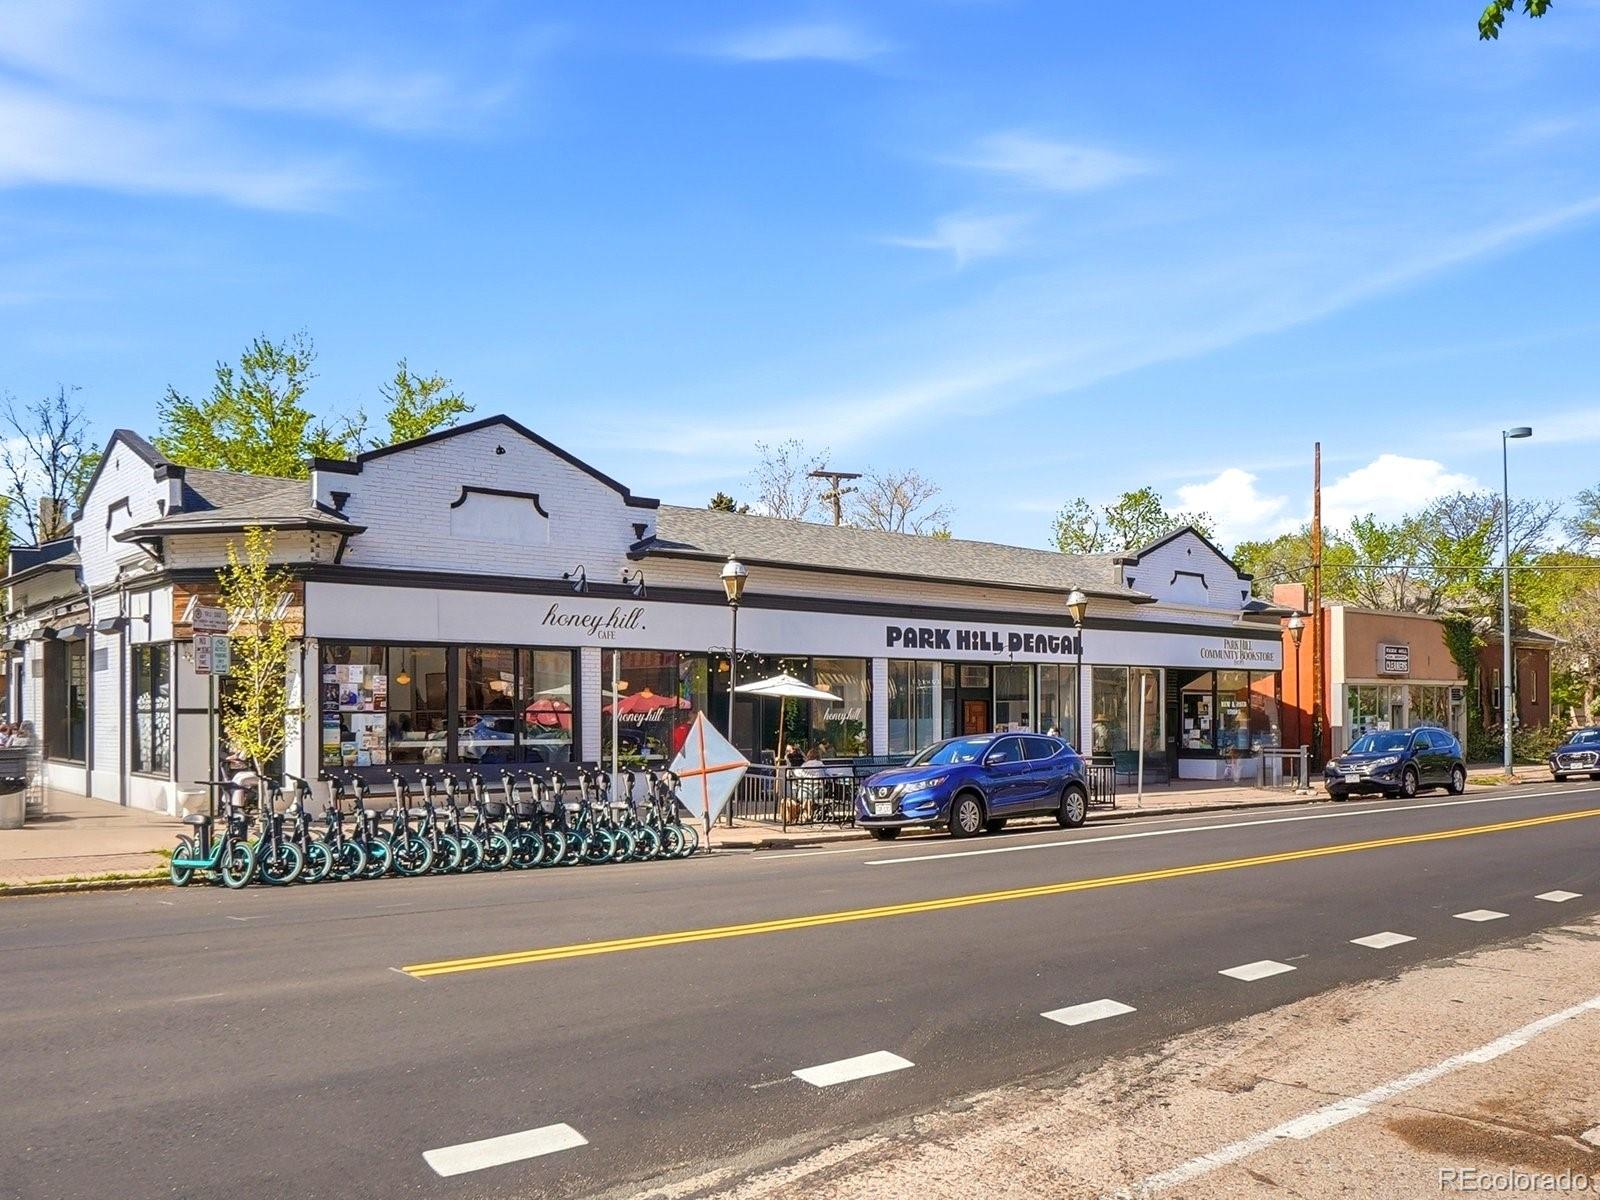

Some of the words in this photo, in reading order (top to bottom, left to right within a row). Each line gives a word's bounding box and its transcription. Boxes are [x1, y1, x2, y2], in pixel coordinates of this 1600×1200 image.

[541, 603, 604, 636] honey
[597, 630, 616, 640] CAFE
[886, 626, 950, 649] PARK
[1200, 647, 1238, 660] COMMUNITY
[1239, 650, 1274, 661] BOOKSTORE
